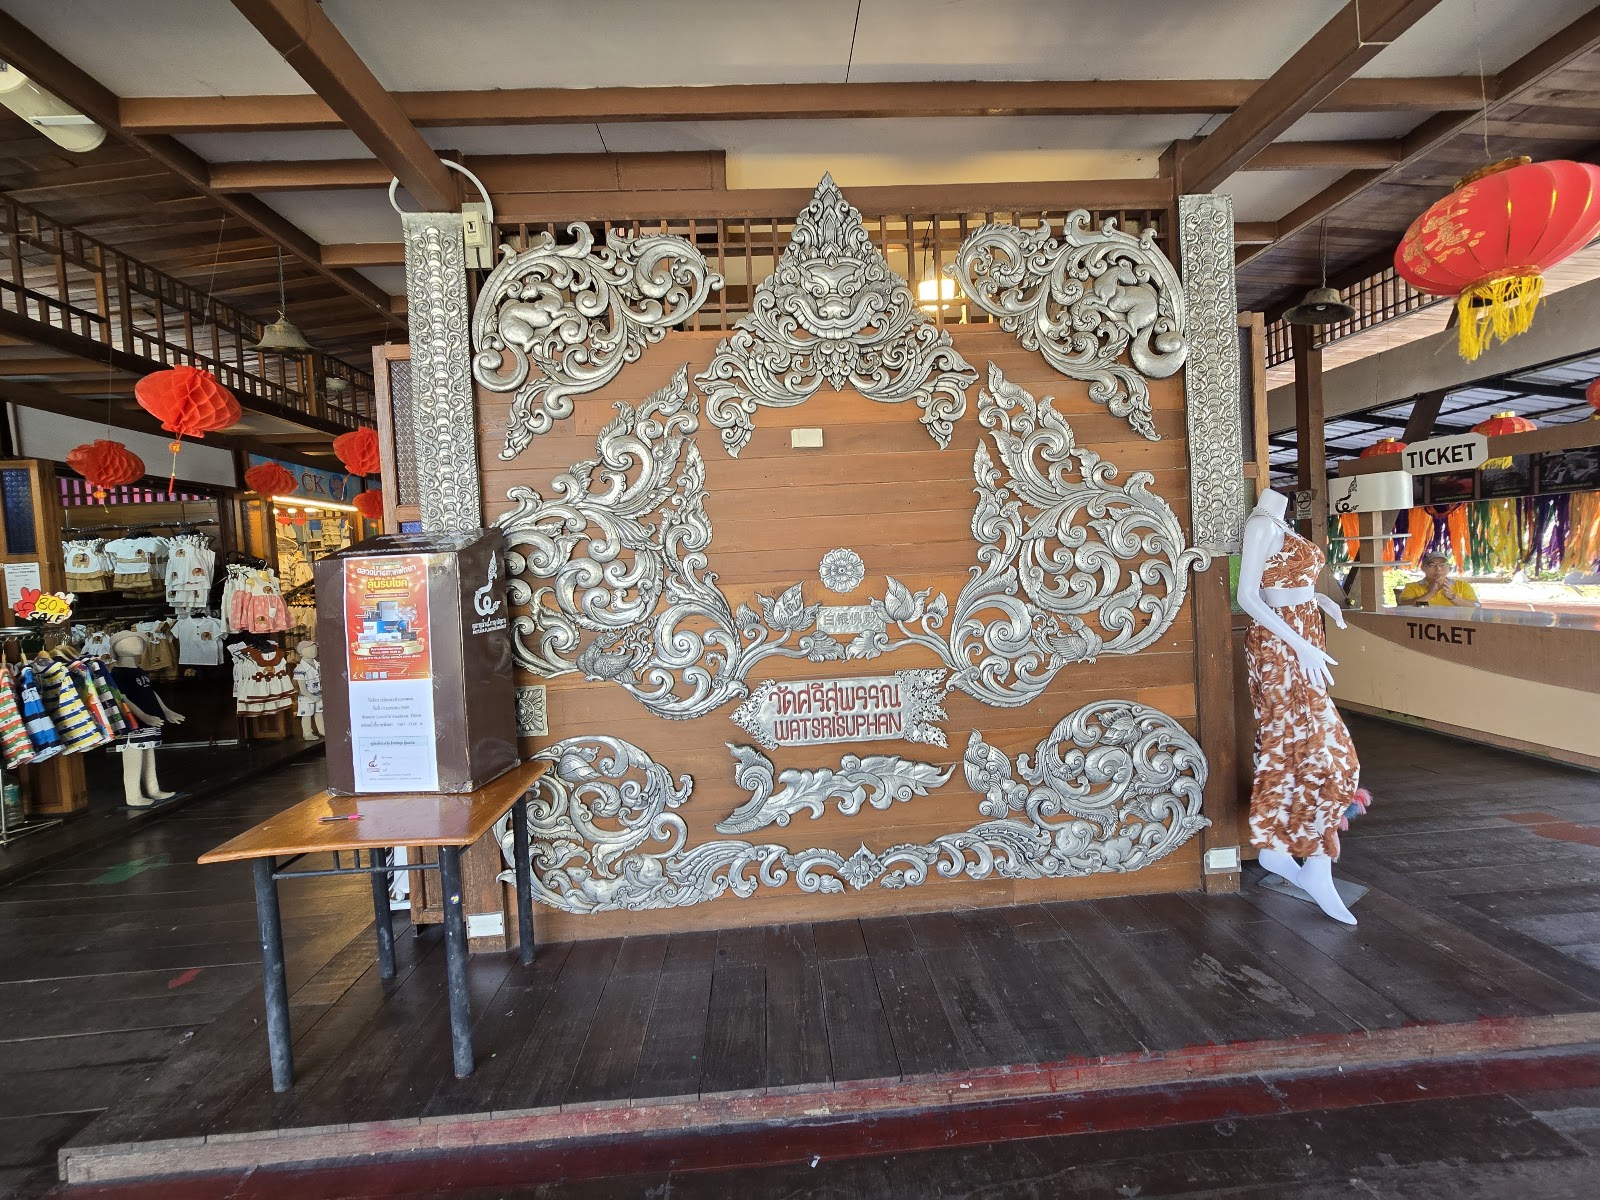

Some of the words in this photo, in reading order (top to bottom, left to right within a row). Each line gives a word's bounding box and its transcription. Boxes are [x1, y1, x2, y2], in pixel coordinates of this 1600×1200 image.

[1406, 442, 1476, 469] TICKET
[38, 597, 57, 611] 80
[30, 611, 64, 623] SALE
[768, 682, 902, 718] วัดศรีสุพรรณ
